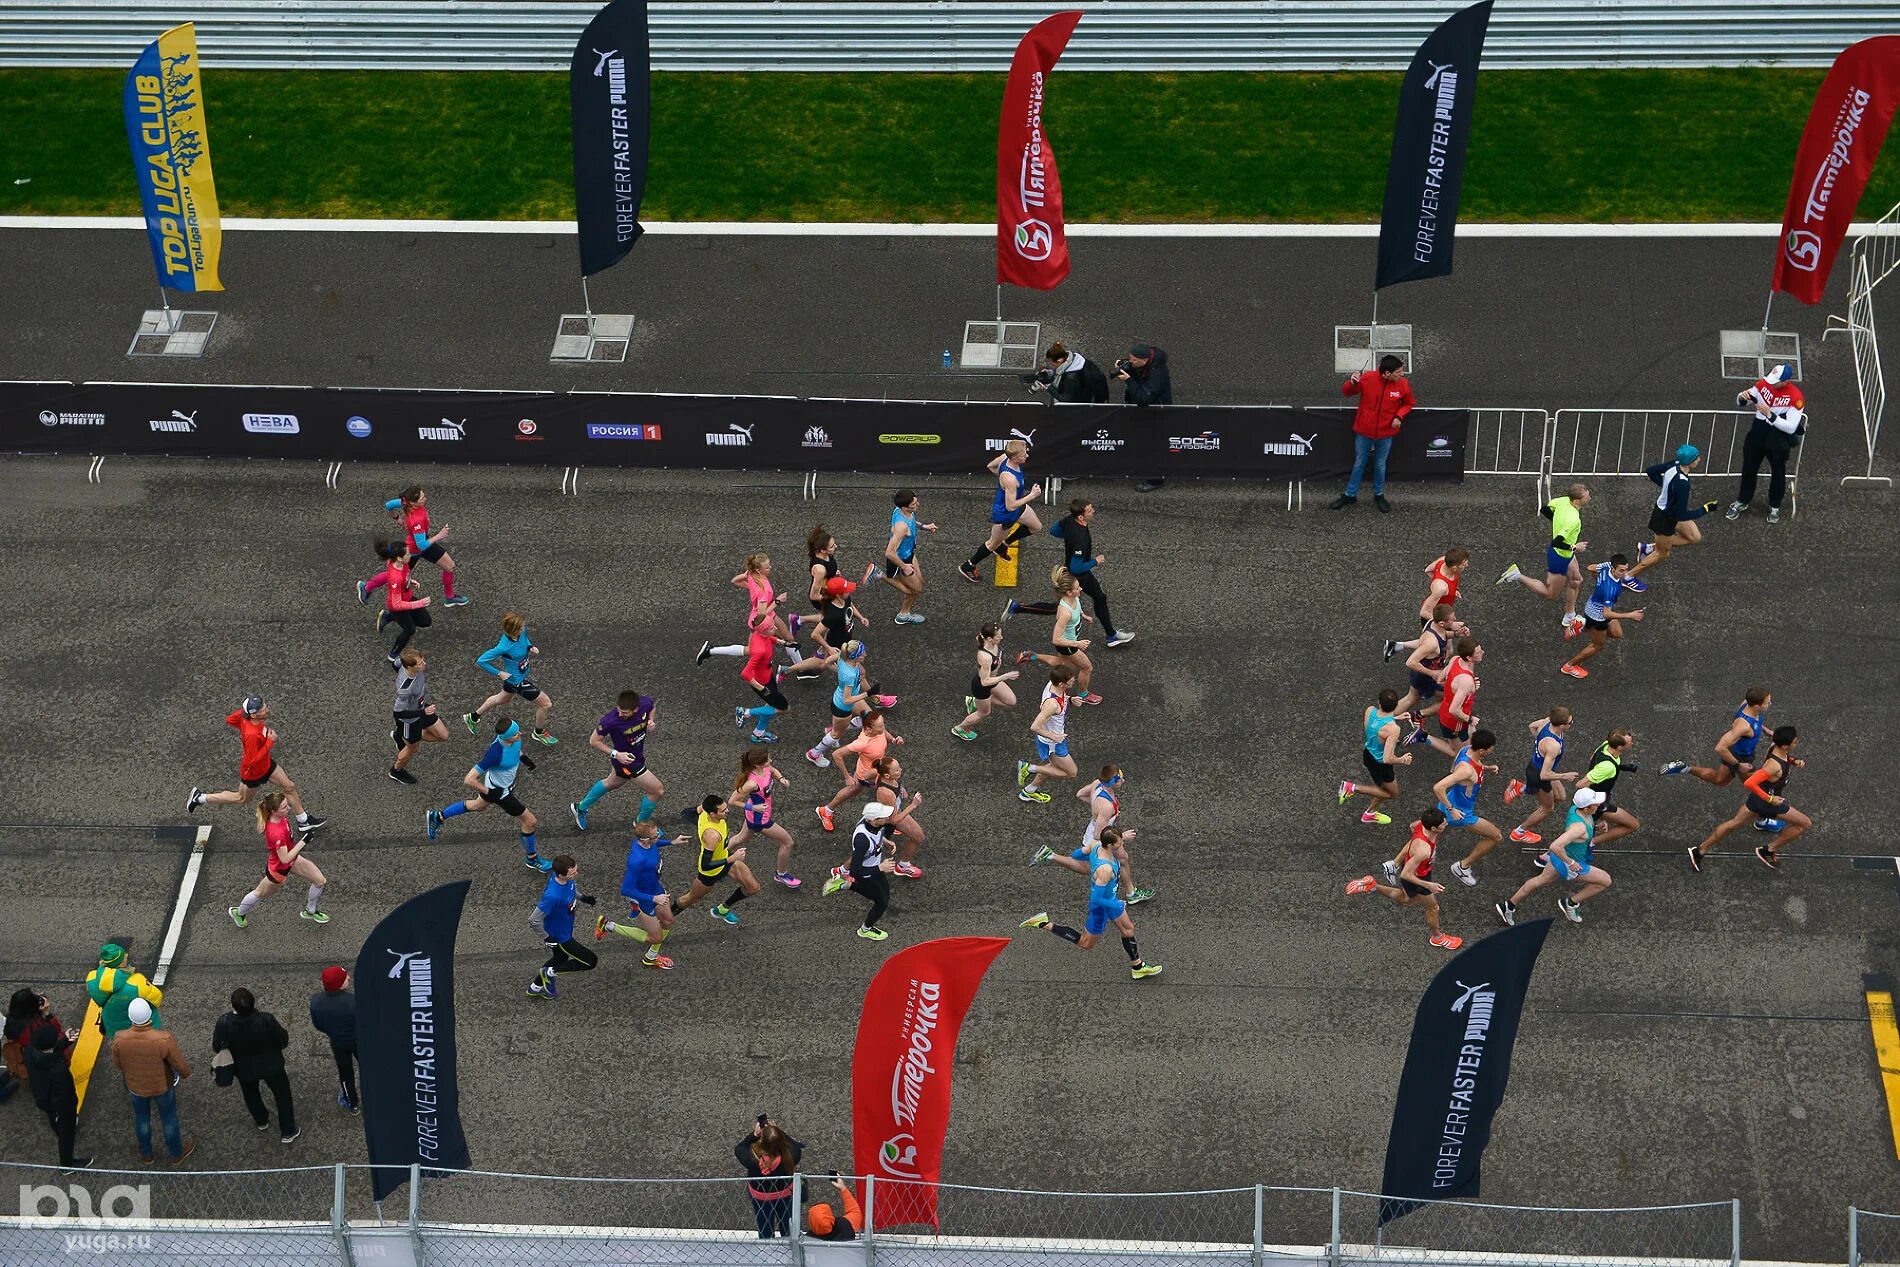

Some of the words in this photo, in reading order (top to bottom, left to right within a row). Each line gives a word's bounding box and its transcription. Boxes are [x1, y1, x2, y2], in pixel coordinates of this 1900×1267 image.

[608, 58, 627, 105] PUMA
[1434, 71, 1457, 121] PUMA
[135, 74, 168, 146] CLUB
[147, 150, 184, 214] LIGA
[160, 214, 190, 275] TOP
[183, 186, 205, 271] TopLigaRun.ru
[59, 417, 105, 425] PHOTO
[149, 420, 191, 432] PUMA
[418, 427, 459, 440] PUMA
[592, 426, 639, 436] РОССИЯ
[647, 426, 656, 439] 1
[705, 433, 746, 446] PUMA
[1169, 437, 1220, 445] SOCHI
[1263, 443, 1305, 456] PUMA
[409, 957, 433, 1008] PUMA
[901, 979, 919, 1039] УНИВЕРСАМ
[1464, 991, 1496, 1042] PUMA
